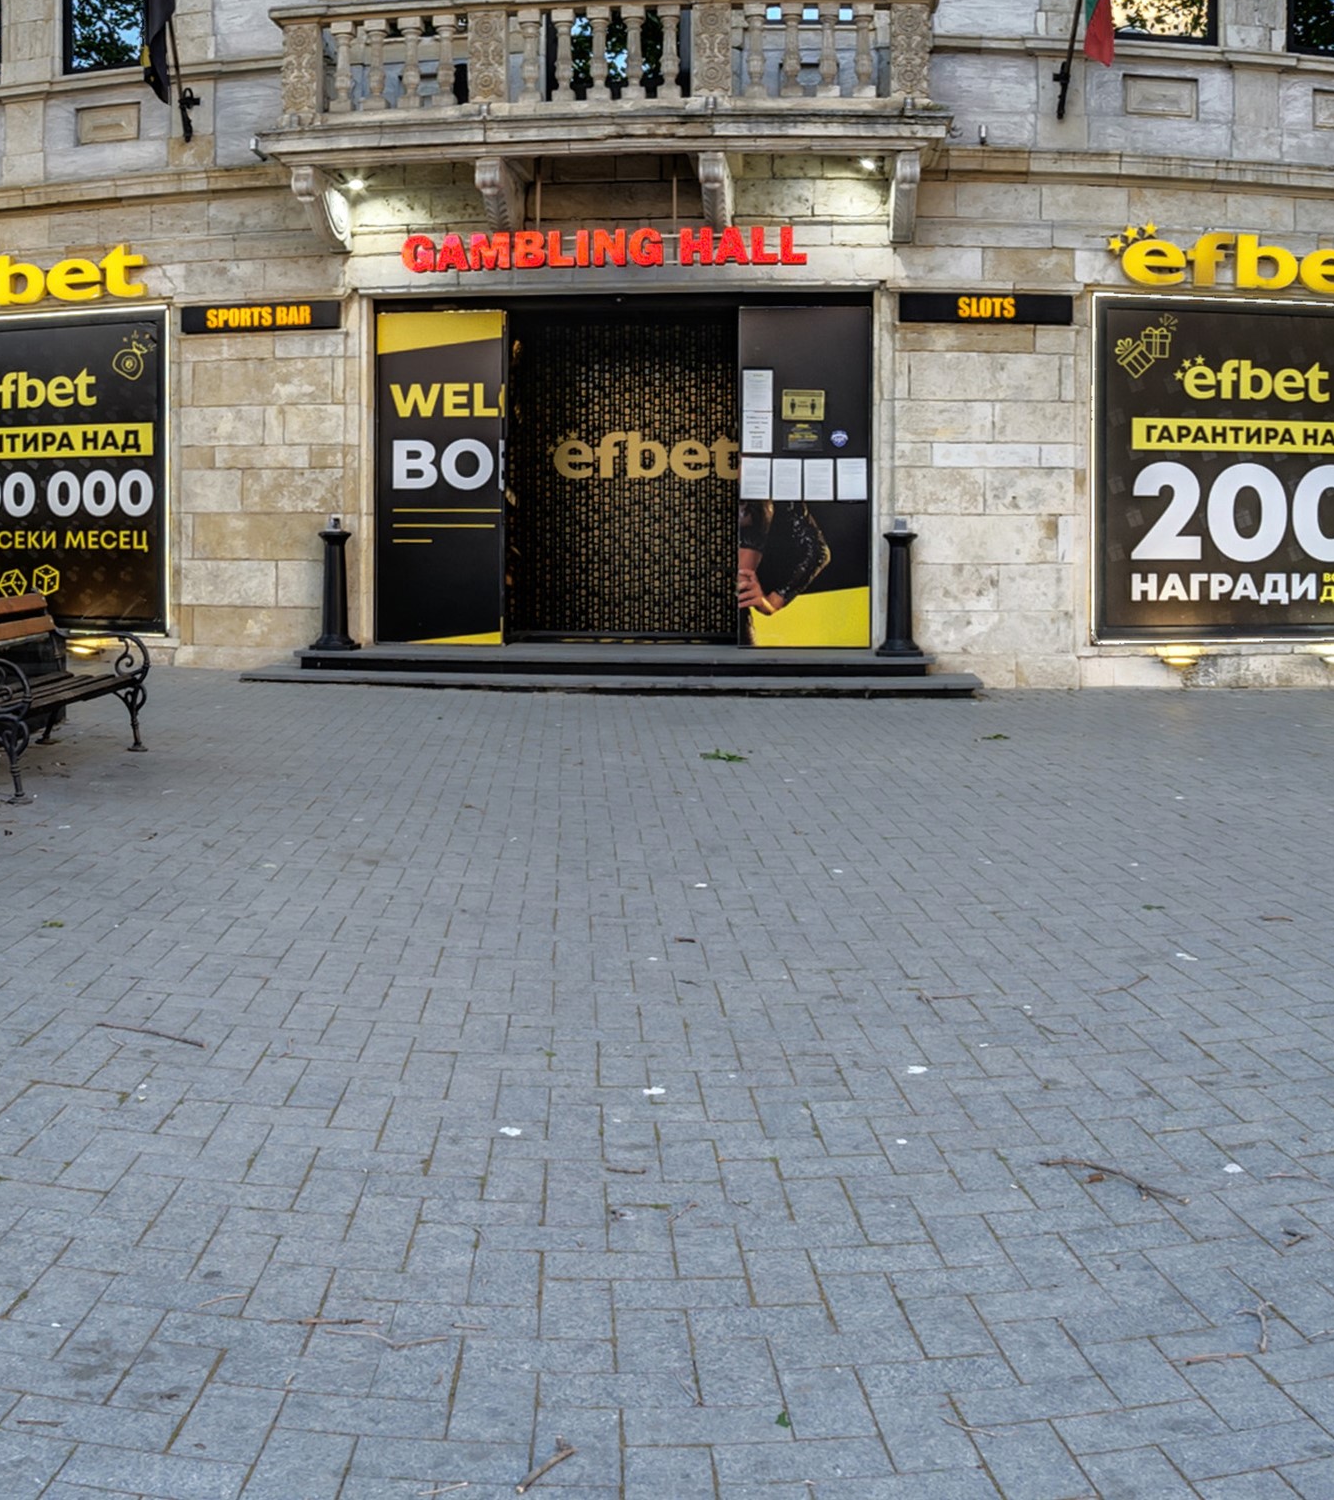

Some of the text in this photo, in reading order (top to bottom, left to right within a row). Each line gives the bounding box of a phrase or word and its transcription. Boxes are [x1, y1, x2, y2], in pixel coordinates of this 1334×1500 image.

[401, 225, 808, 272] GAMBLING HALL
[206, 305, 311, 328] SPORTS BAR
[957, 296, 1016, 318] SLOTS
[1183, 361, 1331, 402] efbet
[389, 383, 505, 418] WEL
[81, 428, 141, 454] НАД
[1145, 424, 1296, 448] ГАРАНТИРА
[392, 438, 505, 491] BO
[553, 431, 739, 480] efbet
[64, 530, 149, 553] МЕСЕЦ
[1131, 573, 1317, 605] НАГРАДИ
